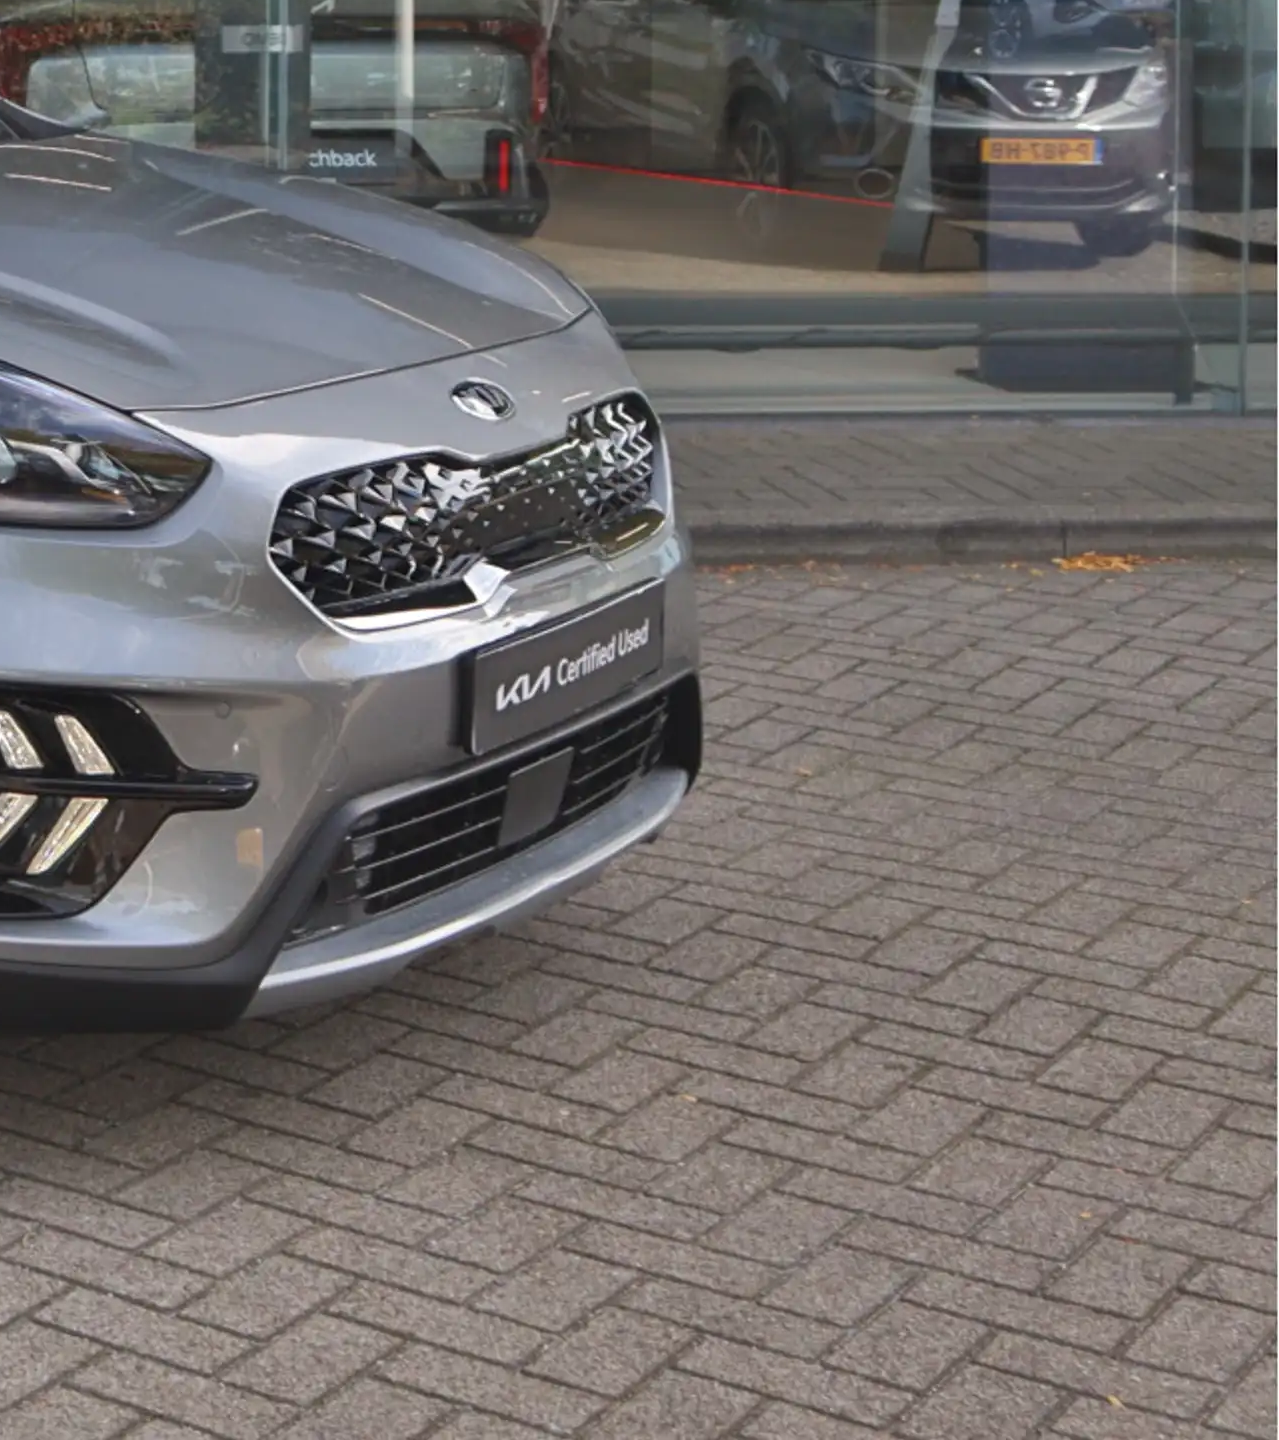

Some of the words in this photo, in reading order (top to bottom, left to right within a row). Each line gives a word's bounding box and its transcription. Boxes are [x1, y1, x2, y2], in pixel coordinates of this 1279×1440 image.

[495, 664, 552, 711] KIA
[556, 634, 616, 687] Certified
[617, 617, 650, 656] Used
